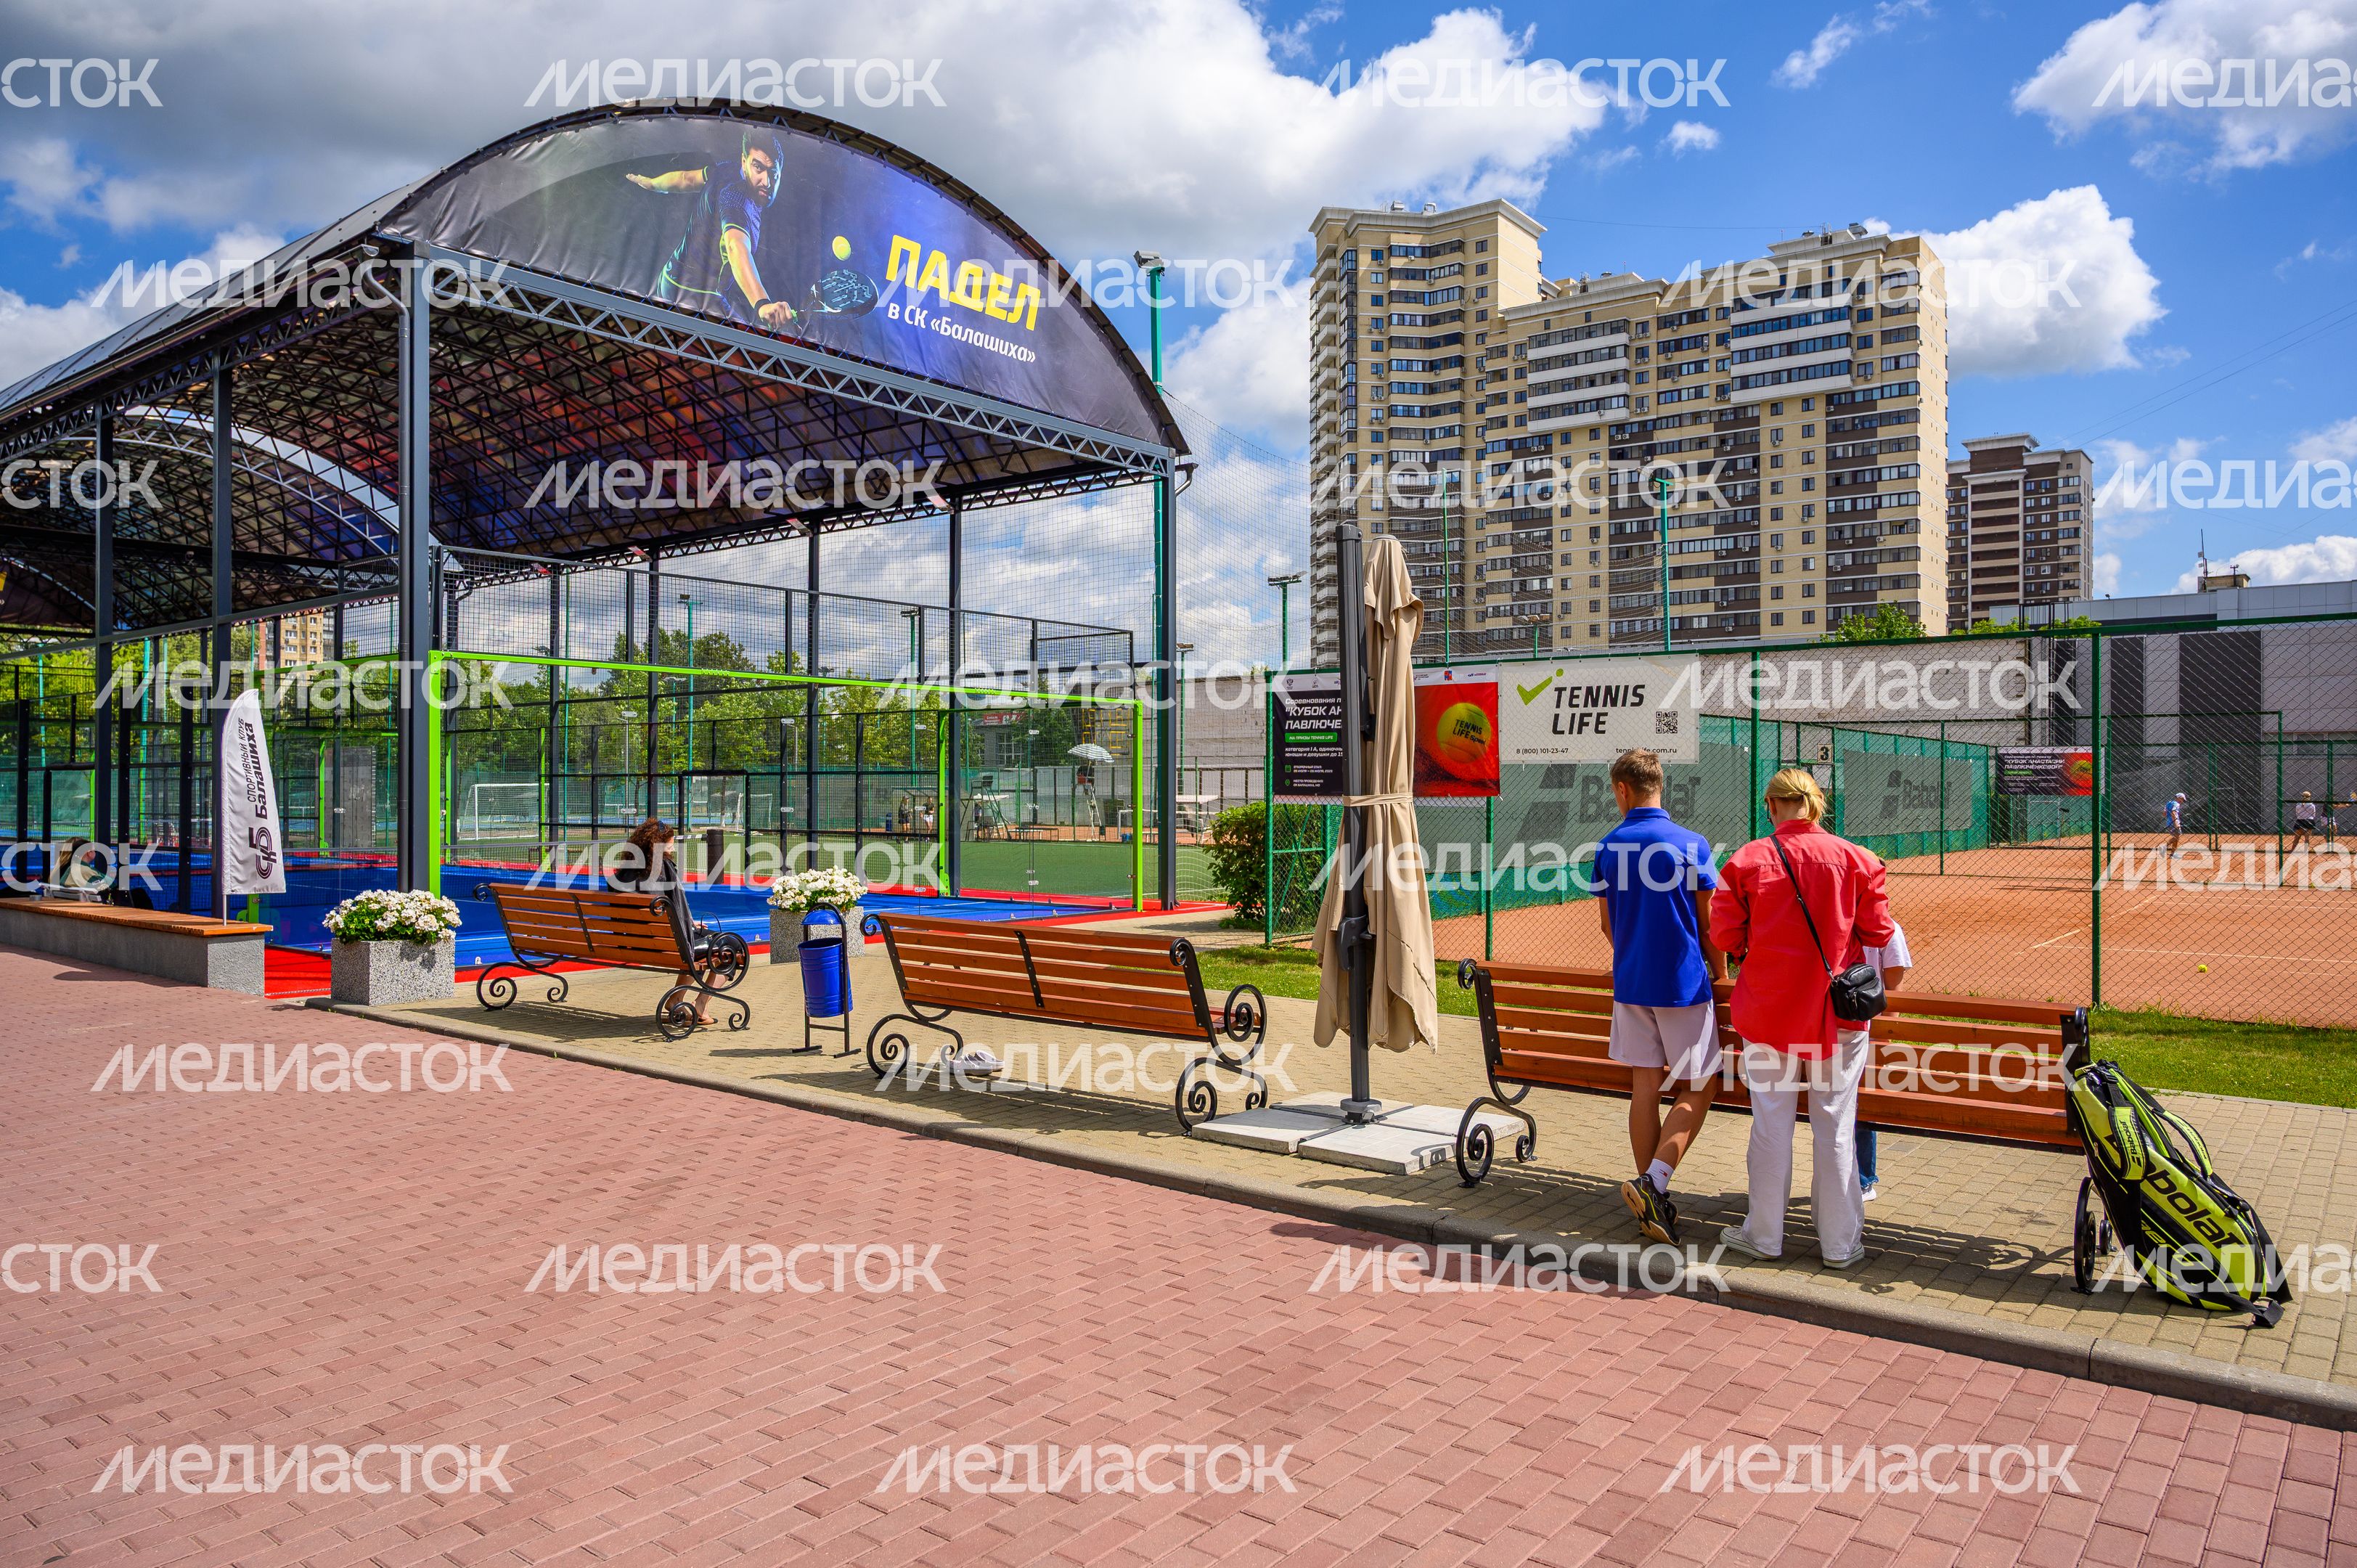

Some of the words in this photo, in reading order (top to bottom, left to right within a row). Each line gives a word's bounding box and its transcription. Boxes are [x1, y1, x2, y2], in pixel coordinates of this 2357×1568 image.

[886, 234, 1041, 331] ПАДЕЛ
[888, 303, 899, 319] в
[904, 305, 928, 328] СК
[931, 317, 1036, 363] «Балашиха»
[1553, 685, 1646, 709] TENNIS
[1453, 727, 1471, 739] LIFE
[1455, 719, 1482, 735] TENNIS
[1552, 712, 1609, 735] LIFE
[1820, 746, 1829, 761] 3
[239, 743, 256, 802] СПОРТИВНЫЙ
[245, 723, 268, 819] Балашиха
